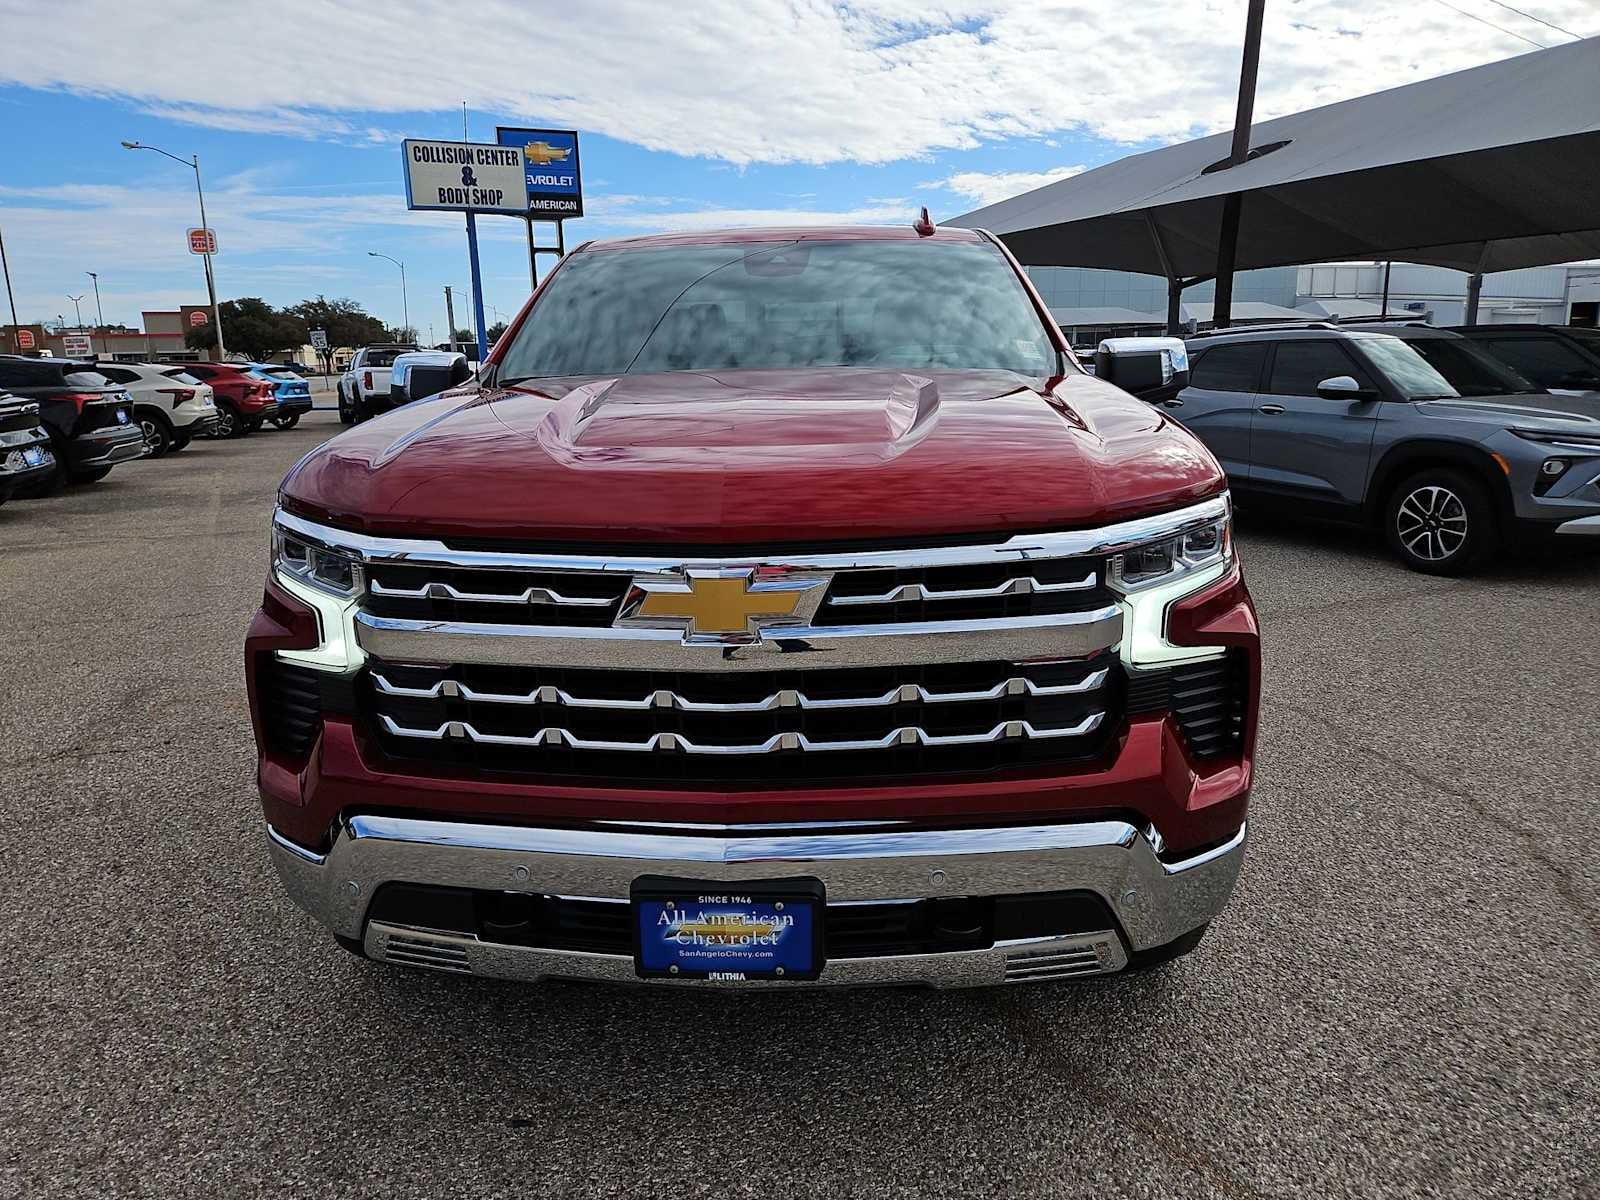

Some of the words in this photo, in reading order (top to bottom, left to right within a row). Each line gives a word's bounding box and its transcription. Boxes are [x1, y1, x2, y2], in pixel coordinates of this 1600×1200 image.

[414, 146, 474, 164] COLLISION
[476, 149, 519, 166] CENTER
[461, 165, 477, 186] &
[438, 187, 470, 204] BODY
[473, 188, 503, 205] SHOP
[530, 199, 577, 210] AMERICAN
[698, 896, 728, 904] SINCE
[657, 910, 686, 926] All
[695, 911, 794, 926] American
[676, 930, 778, 946] Chevrolet
[679, 950, 773, 959] SanAngeloChevy.com
[717, 972, 746, 981] LITHIA
